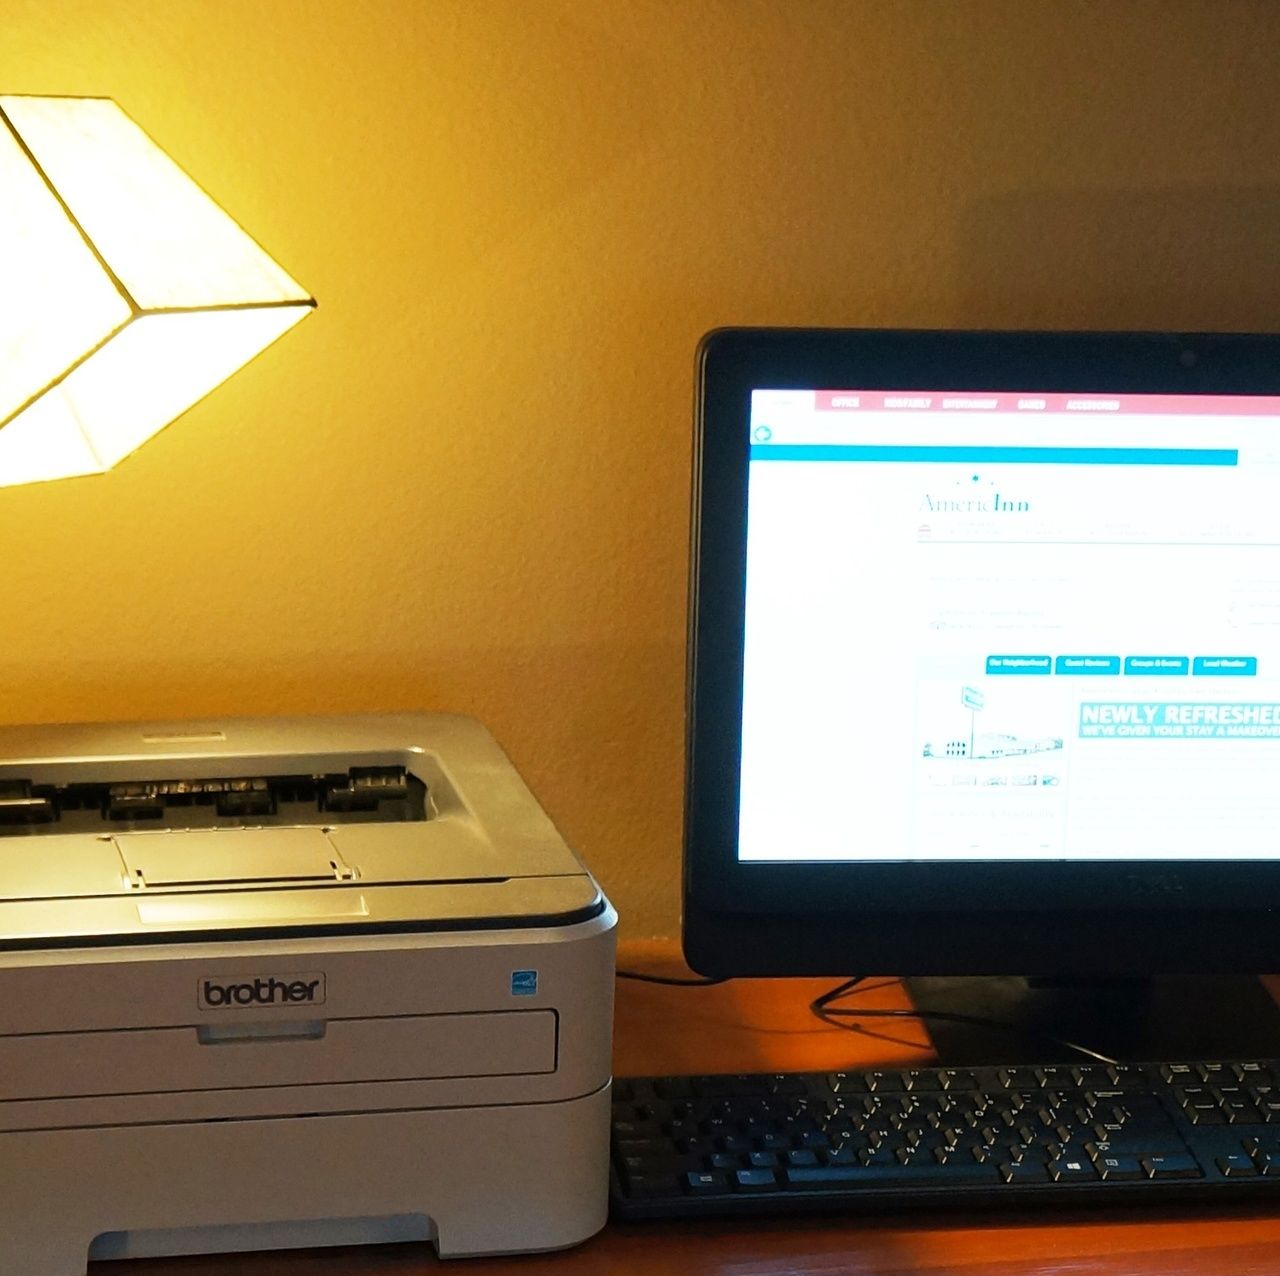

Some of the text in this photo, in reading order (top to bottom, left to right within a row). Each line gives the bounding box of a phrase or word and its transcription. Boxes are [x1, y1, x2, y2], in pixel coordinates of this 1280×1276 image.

[919, 493, 1030, 512] AmericInn
[1082, 704, 1159, 724] NEWLY
[1082, 725, 1115, 737] WE'VE
[1117, 725, 1150, 737] GIVEN
[1154, 725, 1184, 737] YOUR
[1186, 725, 1214, 737] STAY
[1216, 726, 1225, 737] A
[203, 978, 320, 1006] brother
